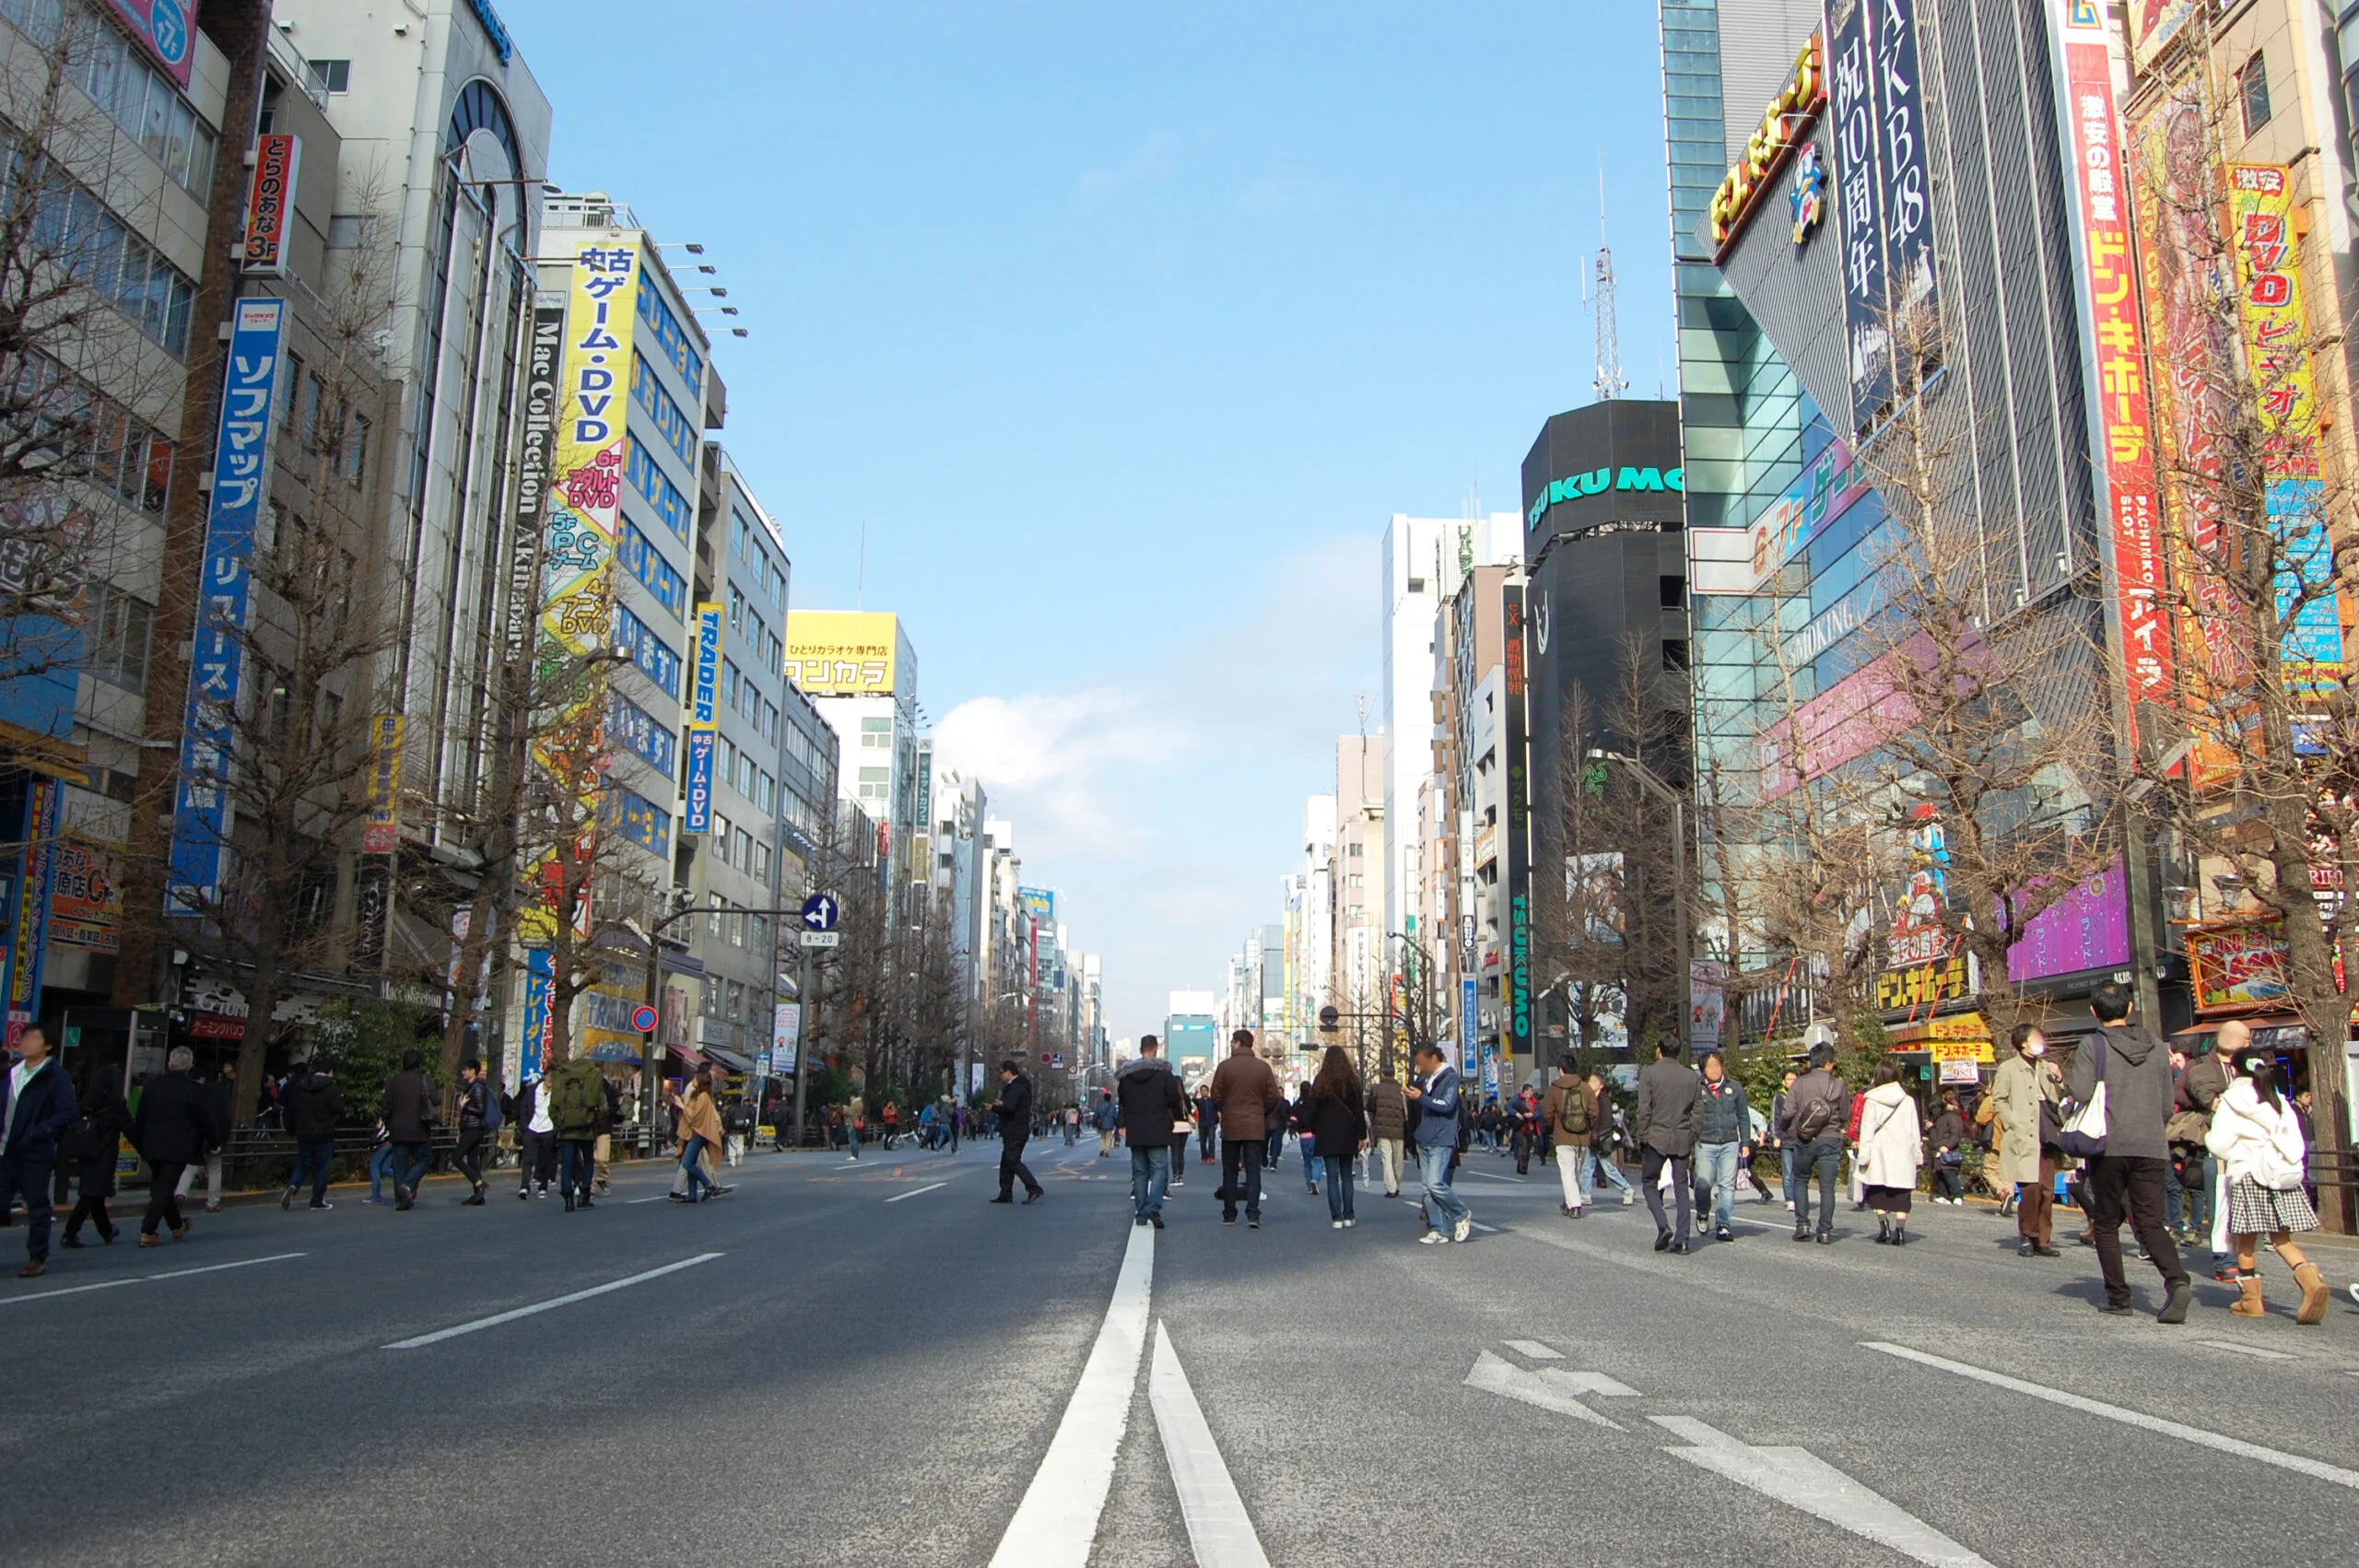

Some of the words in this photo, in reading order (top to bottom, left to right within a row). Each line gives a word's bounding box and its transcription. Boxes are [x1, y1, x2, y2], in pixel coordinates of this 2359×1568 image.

[1833, 37, 1878, 298] 祝10周年
[2079, 95, 2117, 222] 激安の殿堂
[254, 138, 286, 233] とらのあな
[247, 236, 276, 260] 3F
[580, 248, 635, 274] 中古
[533, 322, 560, 376] Mac
[575, 277, 625, 442] ゲーム・DVD
[219, 355, 274, 510] ソフマップ
[519, 380, 555, 515] Collection
[567, 469, 619, 490] アダルト
[595, 450, 621, 467] 6F
[553, 513, 577, 532] 5F
[568, 490, 616, 509] DVD
[2120, 495, 2134, 539] SLOT
[552, 532, 598, 555] PC
[2135, 495, 2154, 592] PACHINKO
[2275, 587, 2291, 597] 2F
[695, 610, 720, 723] TRADER
[790, 645, 888, 656] ひとりカラオケ専門店
[692, 734, 712, 745] 中古
[690, 746, 710, 829] ゲーム・DVD
[55, 869, 106, 904] 原店C
[1512, 894, 1529, 1037] TSUKUMO
[526, 977, 543, 1056] トレーダー
